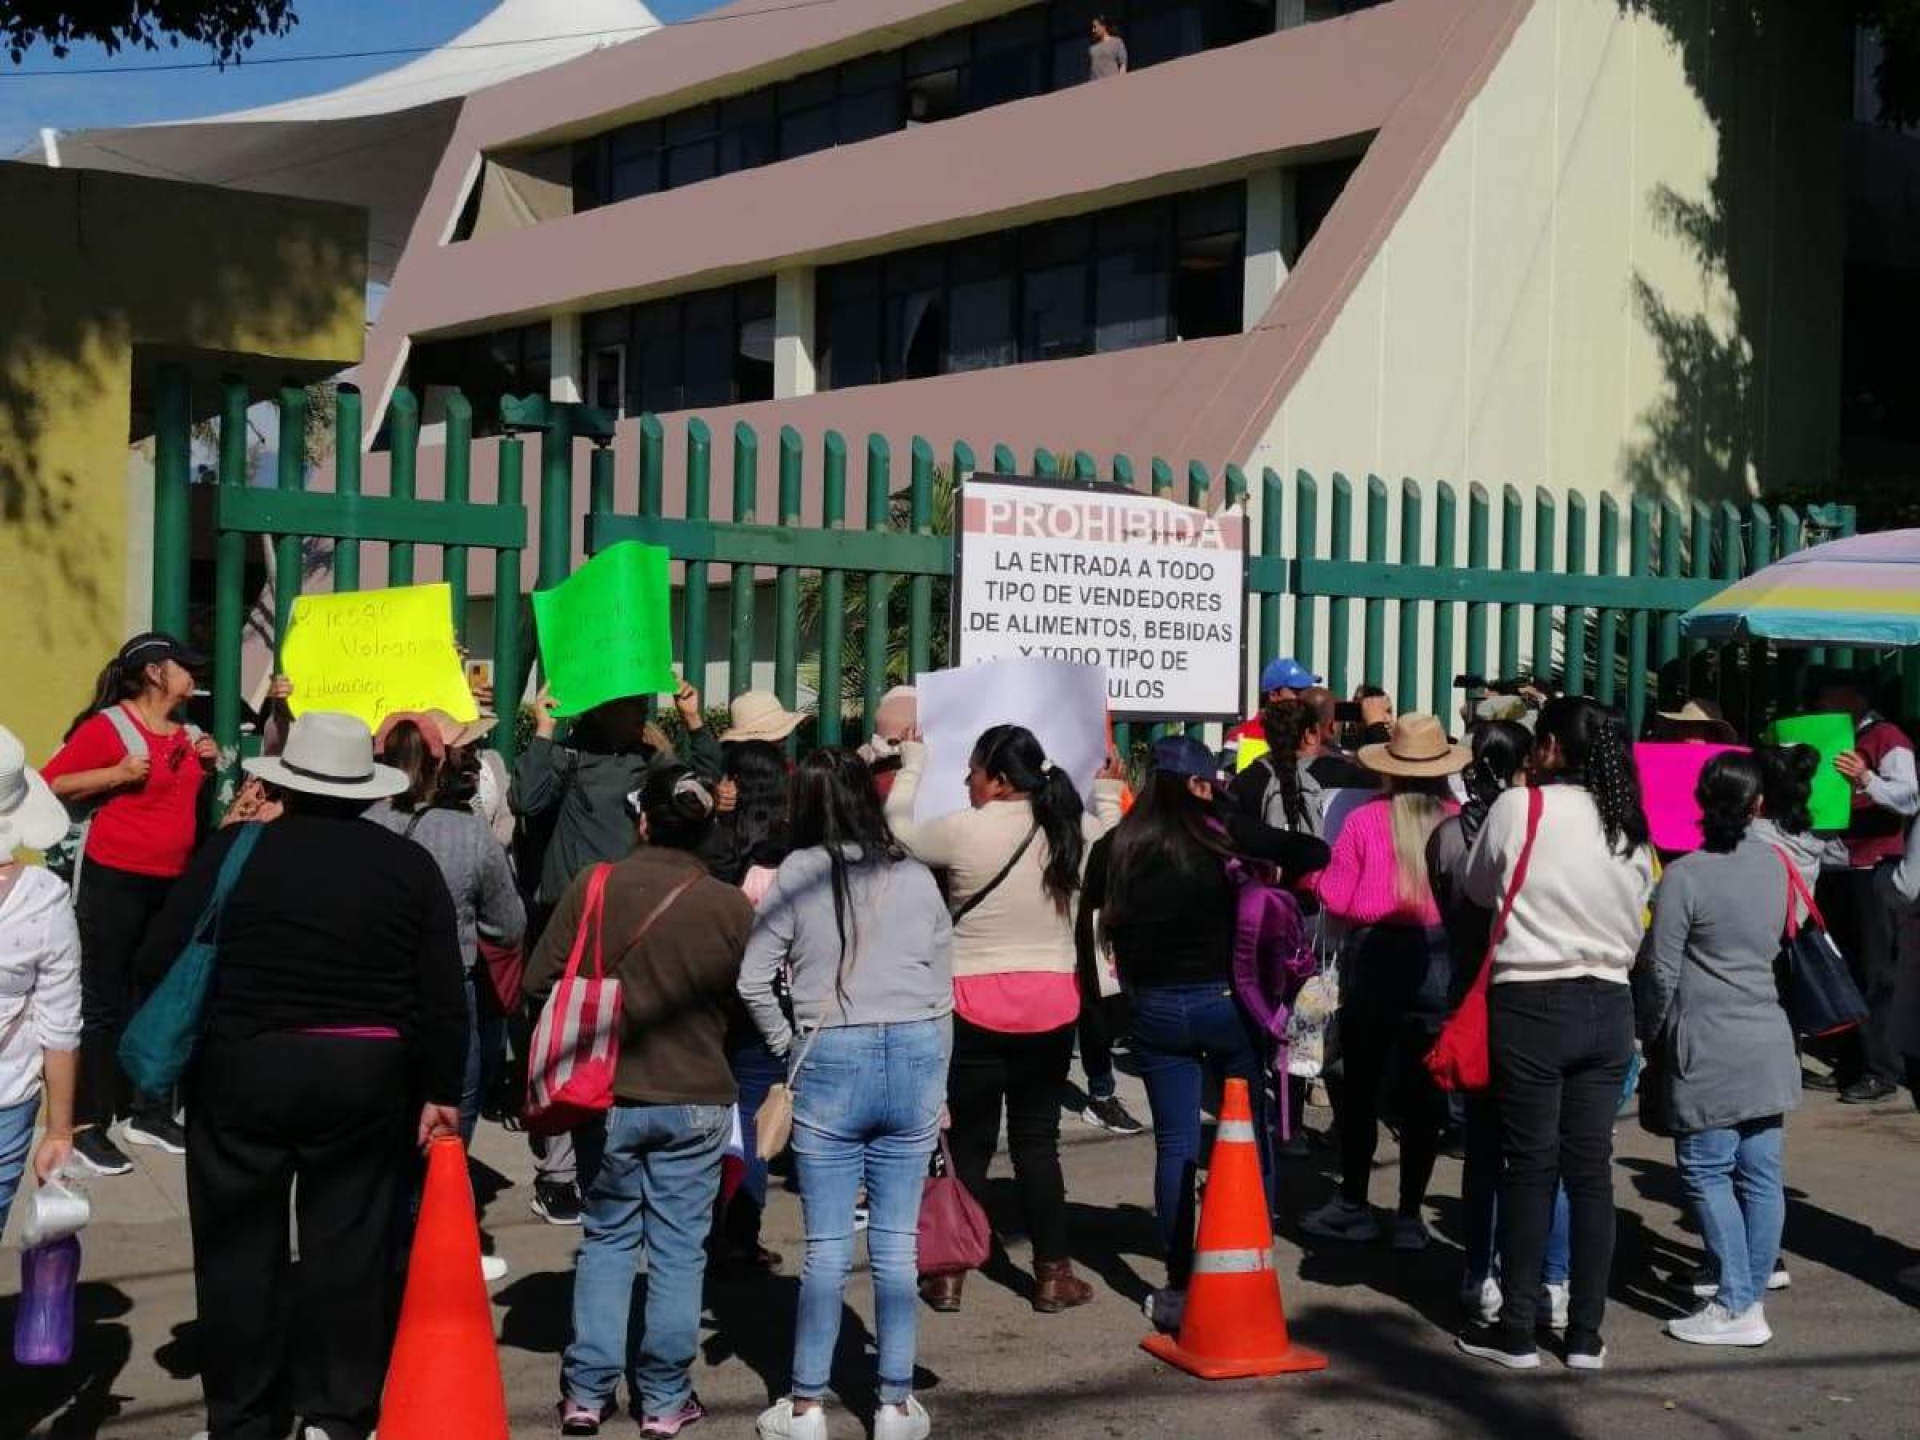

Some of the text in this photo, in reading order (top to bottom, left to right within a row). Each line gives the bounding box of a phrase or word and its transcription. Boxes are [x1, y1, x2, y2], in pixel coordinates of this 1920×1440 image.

[984, 498, 1225, 549] PROHIBIDA
[994, 551, 1215, 581] LA ENTRADA A TODO
[986, 581, 1222, 612] TIPO DE VENDEDORES
[970, 612, 1233, 643] DE ALIMENTOS, BEBIDAS
[1040, 646, 1101, 667] TODO
[1106, 648, 1155, 670] TIPO
[1161, 650, 1189, 671] DE
[1108, 679, 1165, 699] ULOS
